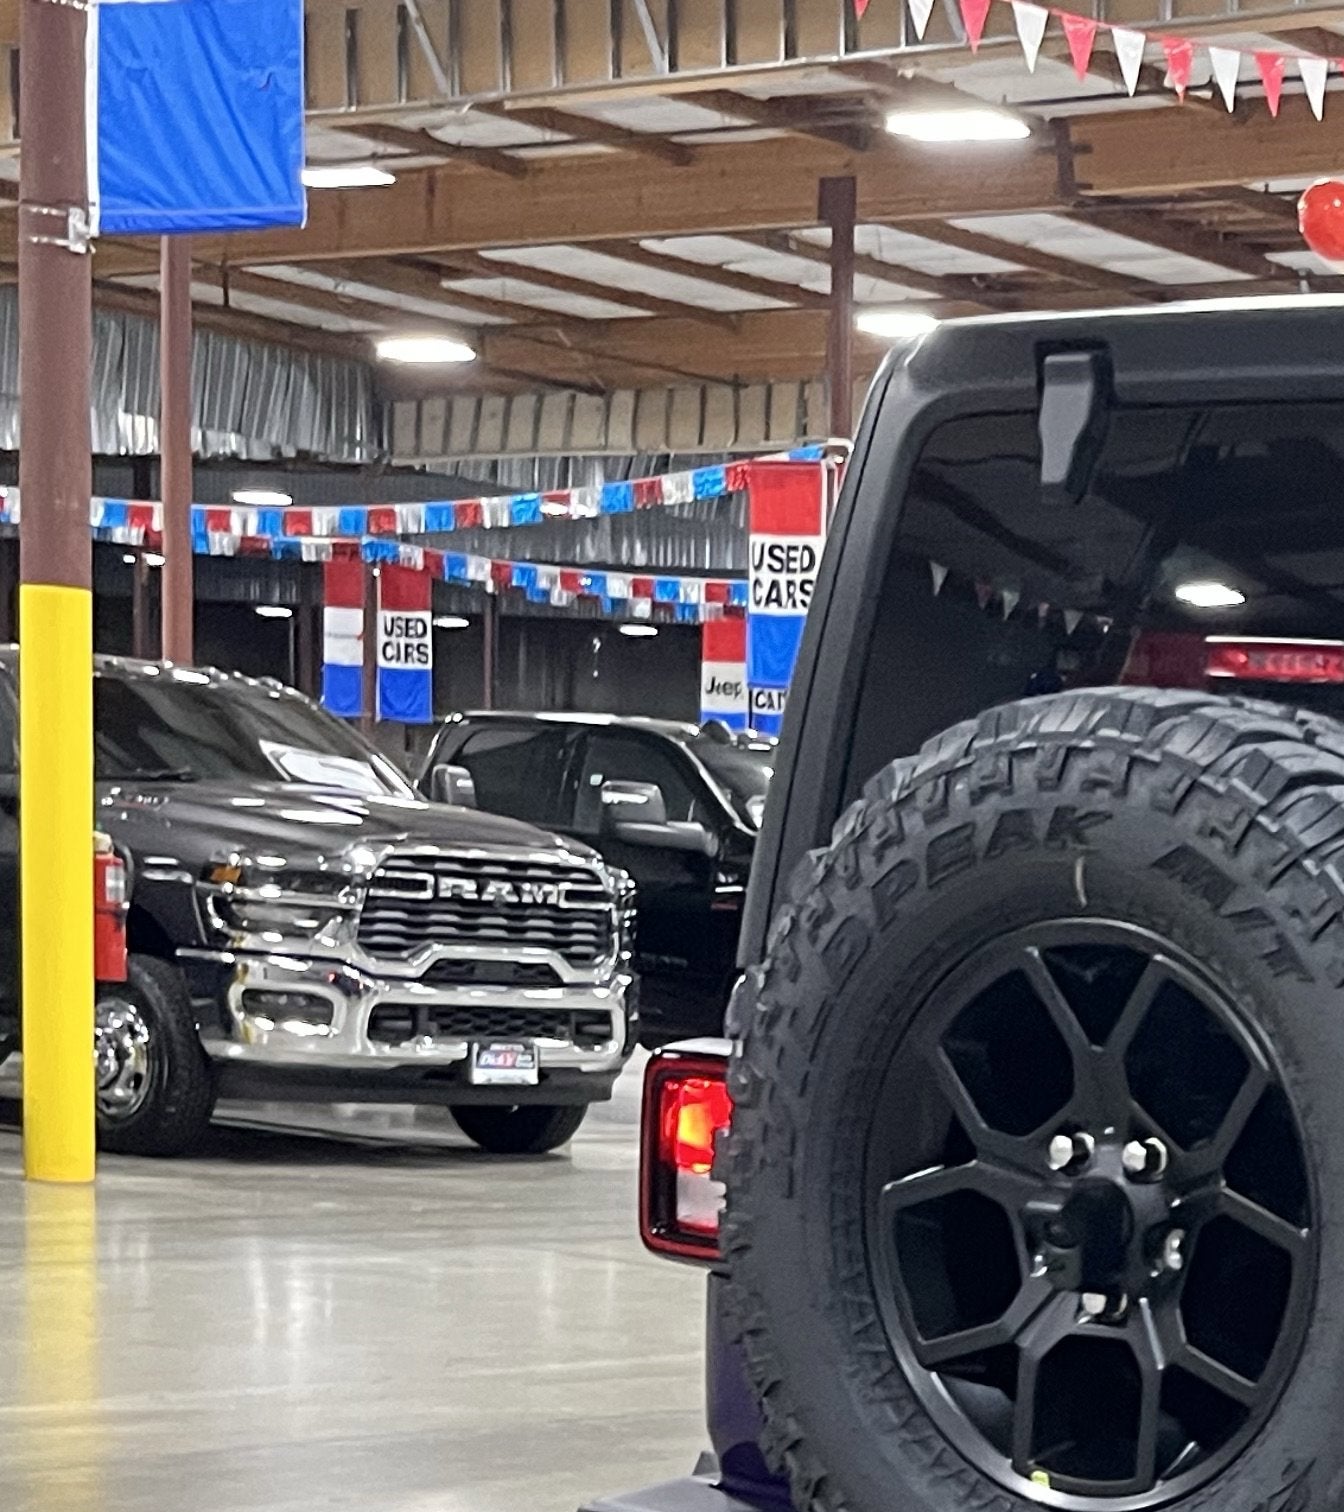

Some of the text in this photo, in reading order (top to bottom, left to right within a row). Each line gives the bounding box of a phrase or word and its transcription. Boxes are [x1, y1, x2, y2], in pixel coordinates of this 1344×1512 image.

[752, 543, 816, 574] USED
[752, 578, 814, 609] CARS
[384, 616, 428, 639] USED
[438, 877, 559, 904] RAM
